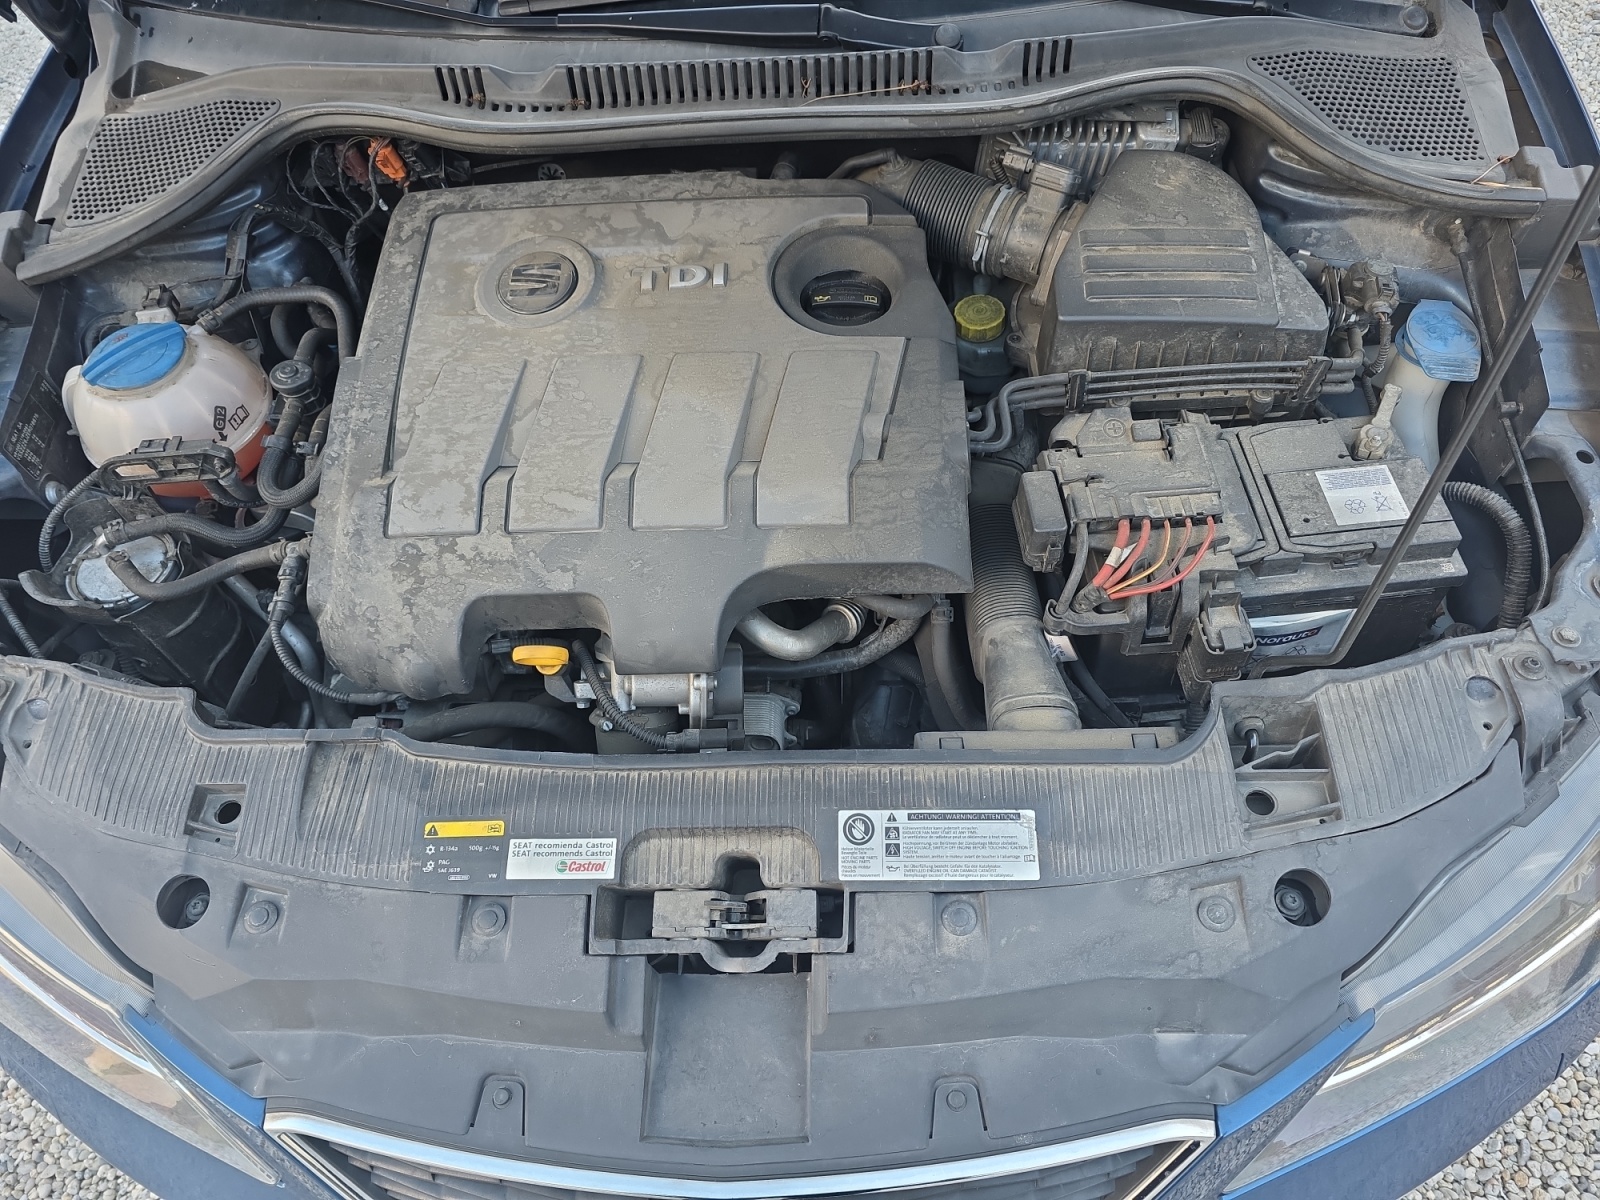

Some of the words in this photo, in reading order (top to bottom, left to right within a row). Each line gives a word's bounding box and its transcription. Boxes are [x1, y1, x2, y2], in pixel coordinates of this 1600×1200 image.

[629, 262, 729, 294] TDI
[216, 408, 225, 428] G12
[1255, 629, 1318, 644] Norauto
[568, 861, 607, 872] Castrol
